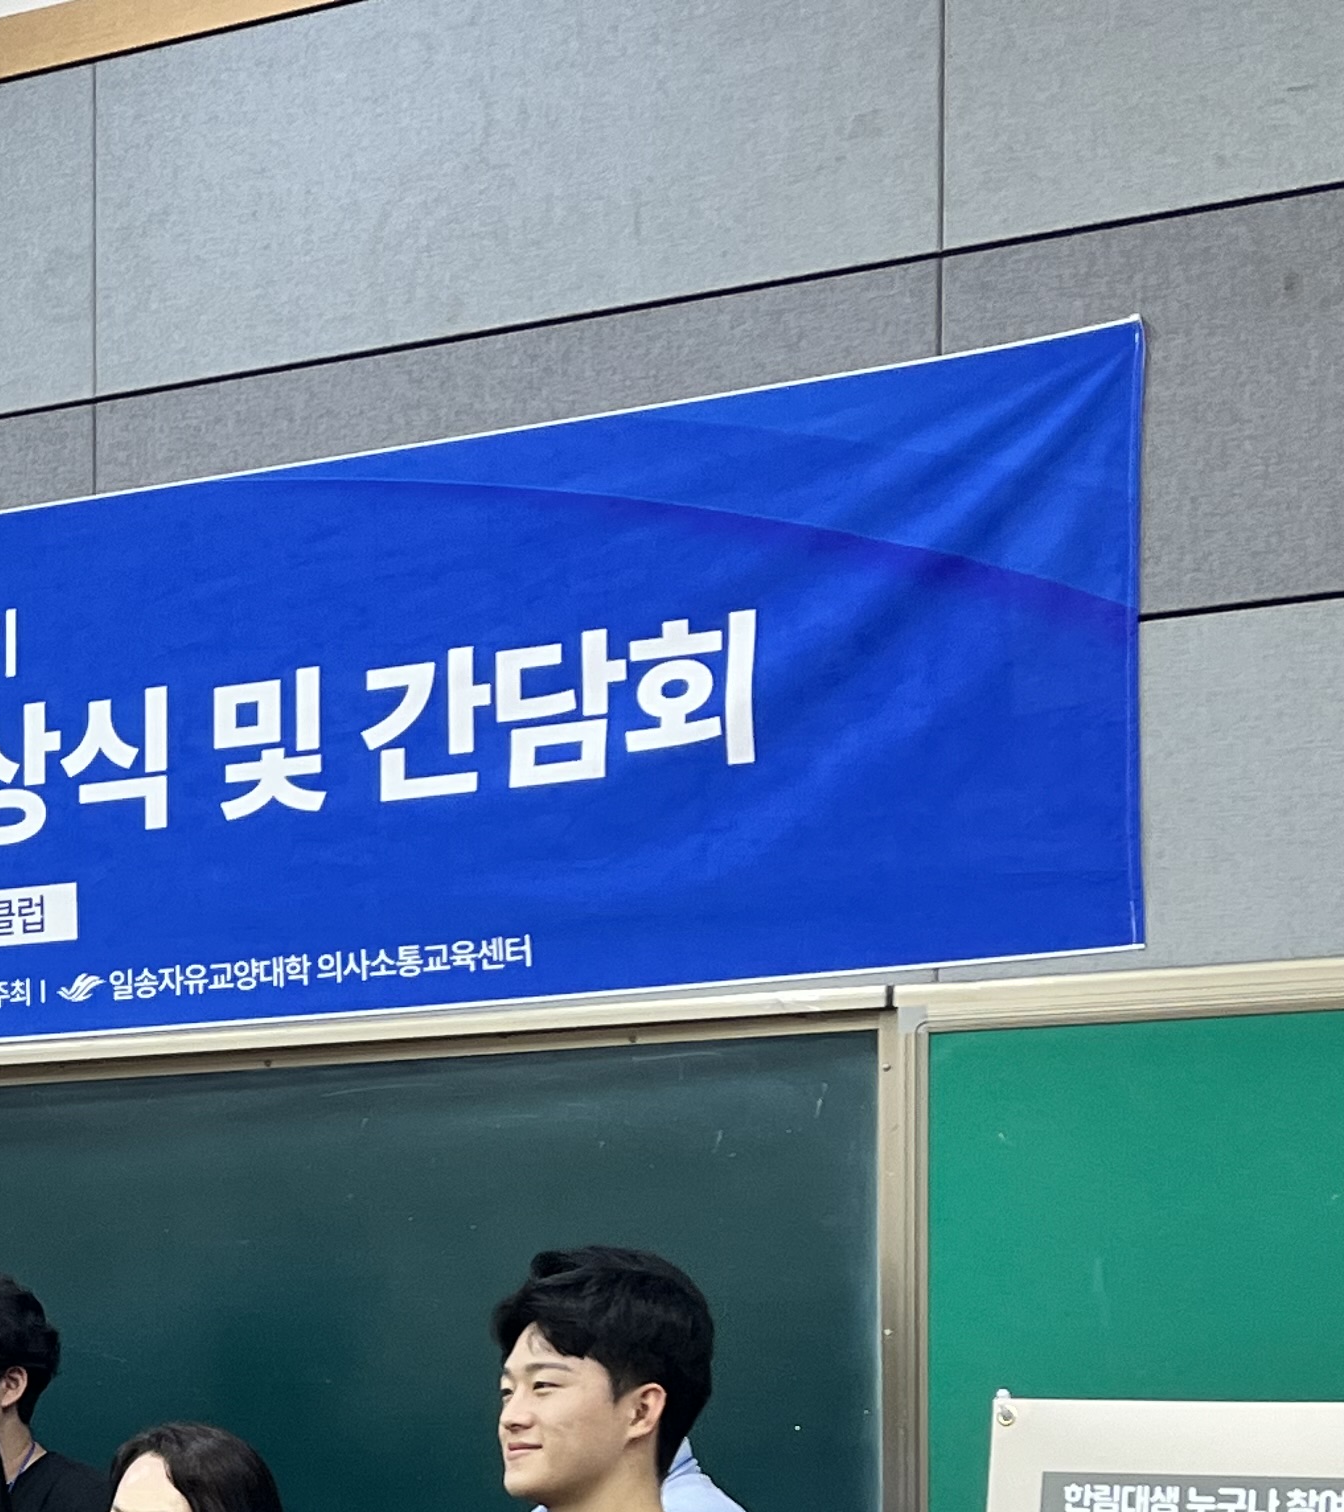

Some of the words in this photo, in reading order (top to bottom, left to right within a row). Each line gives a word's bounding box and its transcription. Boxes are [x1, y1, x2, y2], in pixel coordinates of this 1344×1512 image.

[213, 666, 327, 822] 및
[360, 609, 758, 804] 간담회
[108, 953, 311, 1001] 일송자유교양대학
[316, 934, 533, 985] 의사소통교육센터
